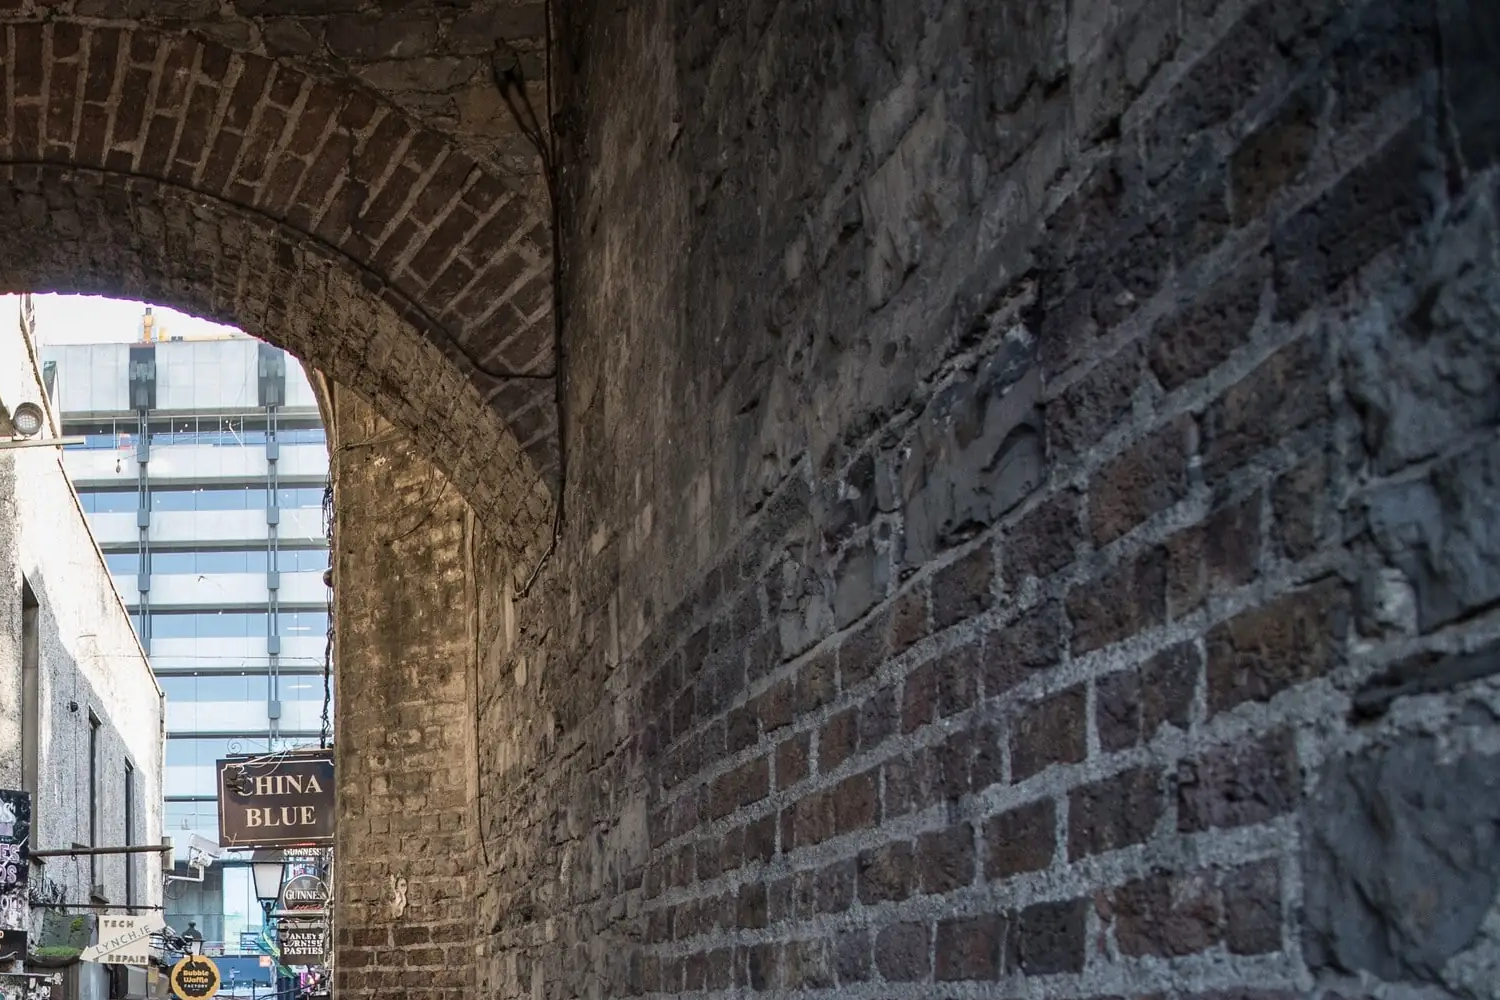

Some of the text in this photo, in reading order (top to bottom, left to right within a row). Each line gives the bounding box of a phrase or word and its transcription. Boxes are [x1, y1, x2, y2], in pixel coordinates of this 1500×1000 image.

[245, 805, 317, 828] BLUE
[104, 920, 134, 928] TECH
[95, 924, 152, 954] LYNCH.IE
[283, 947, 324, 955] PASTIES
[108, 955, 146, 963] REPAIR
[183, 976, 209, 984] Waffle
